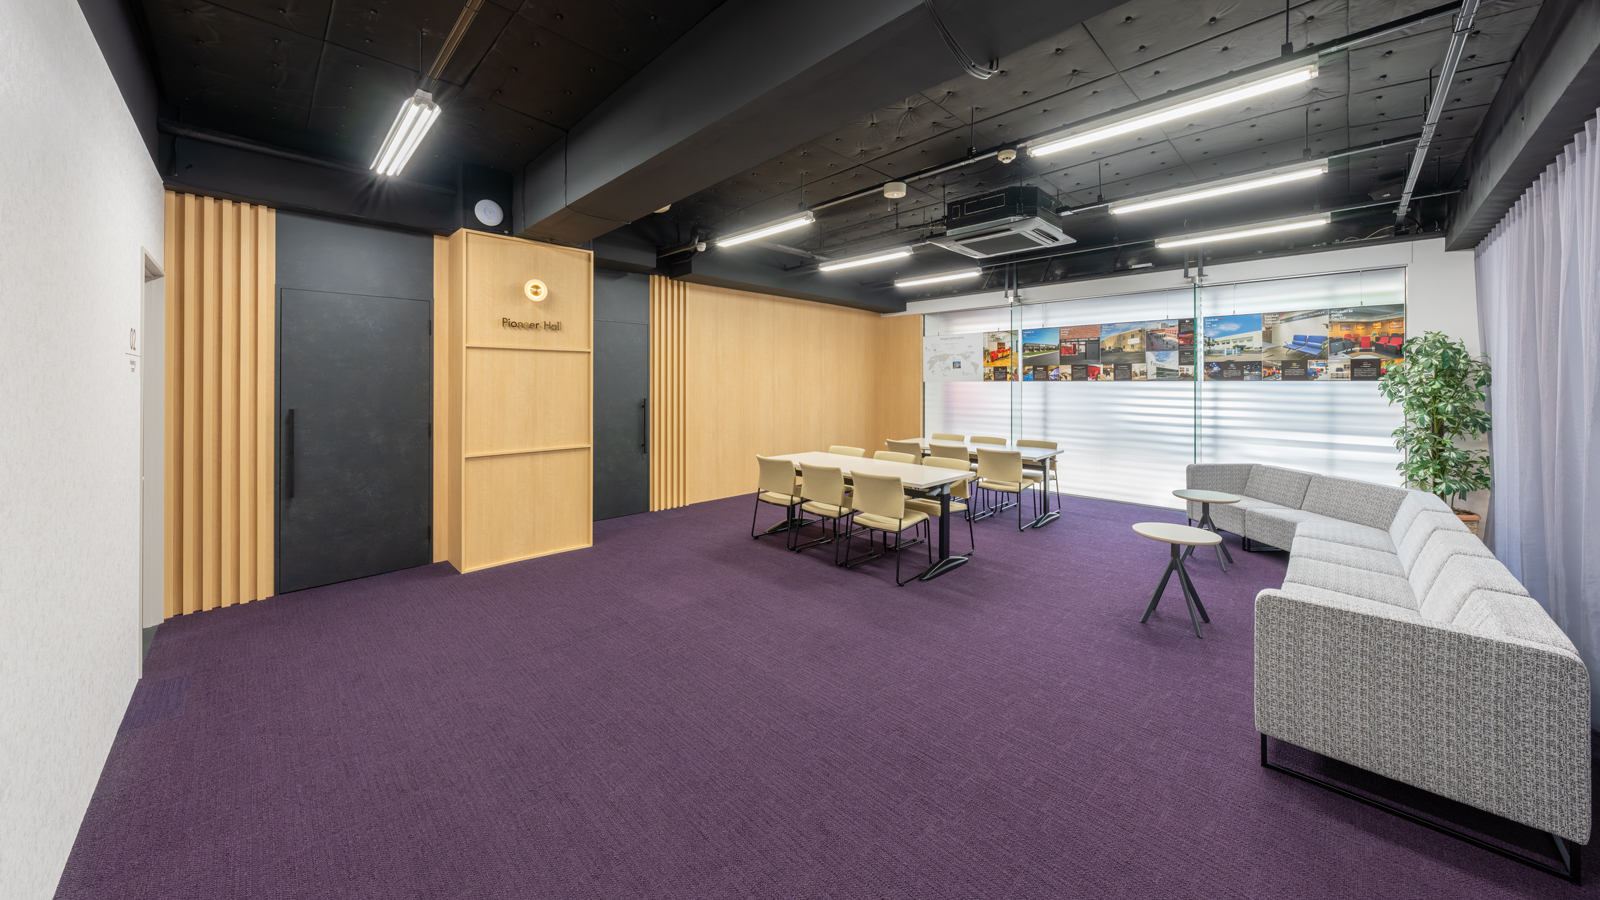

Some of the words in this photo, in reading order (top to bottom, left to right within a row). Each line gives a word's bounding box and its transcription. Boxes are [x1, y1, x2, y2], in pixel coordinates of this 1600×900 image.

[502, 317, 540, 329] Pioneer
[543, 320, 562, 331] Hall
[130, 327, 136, 351] 02
